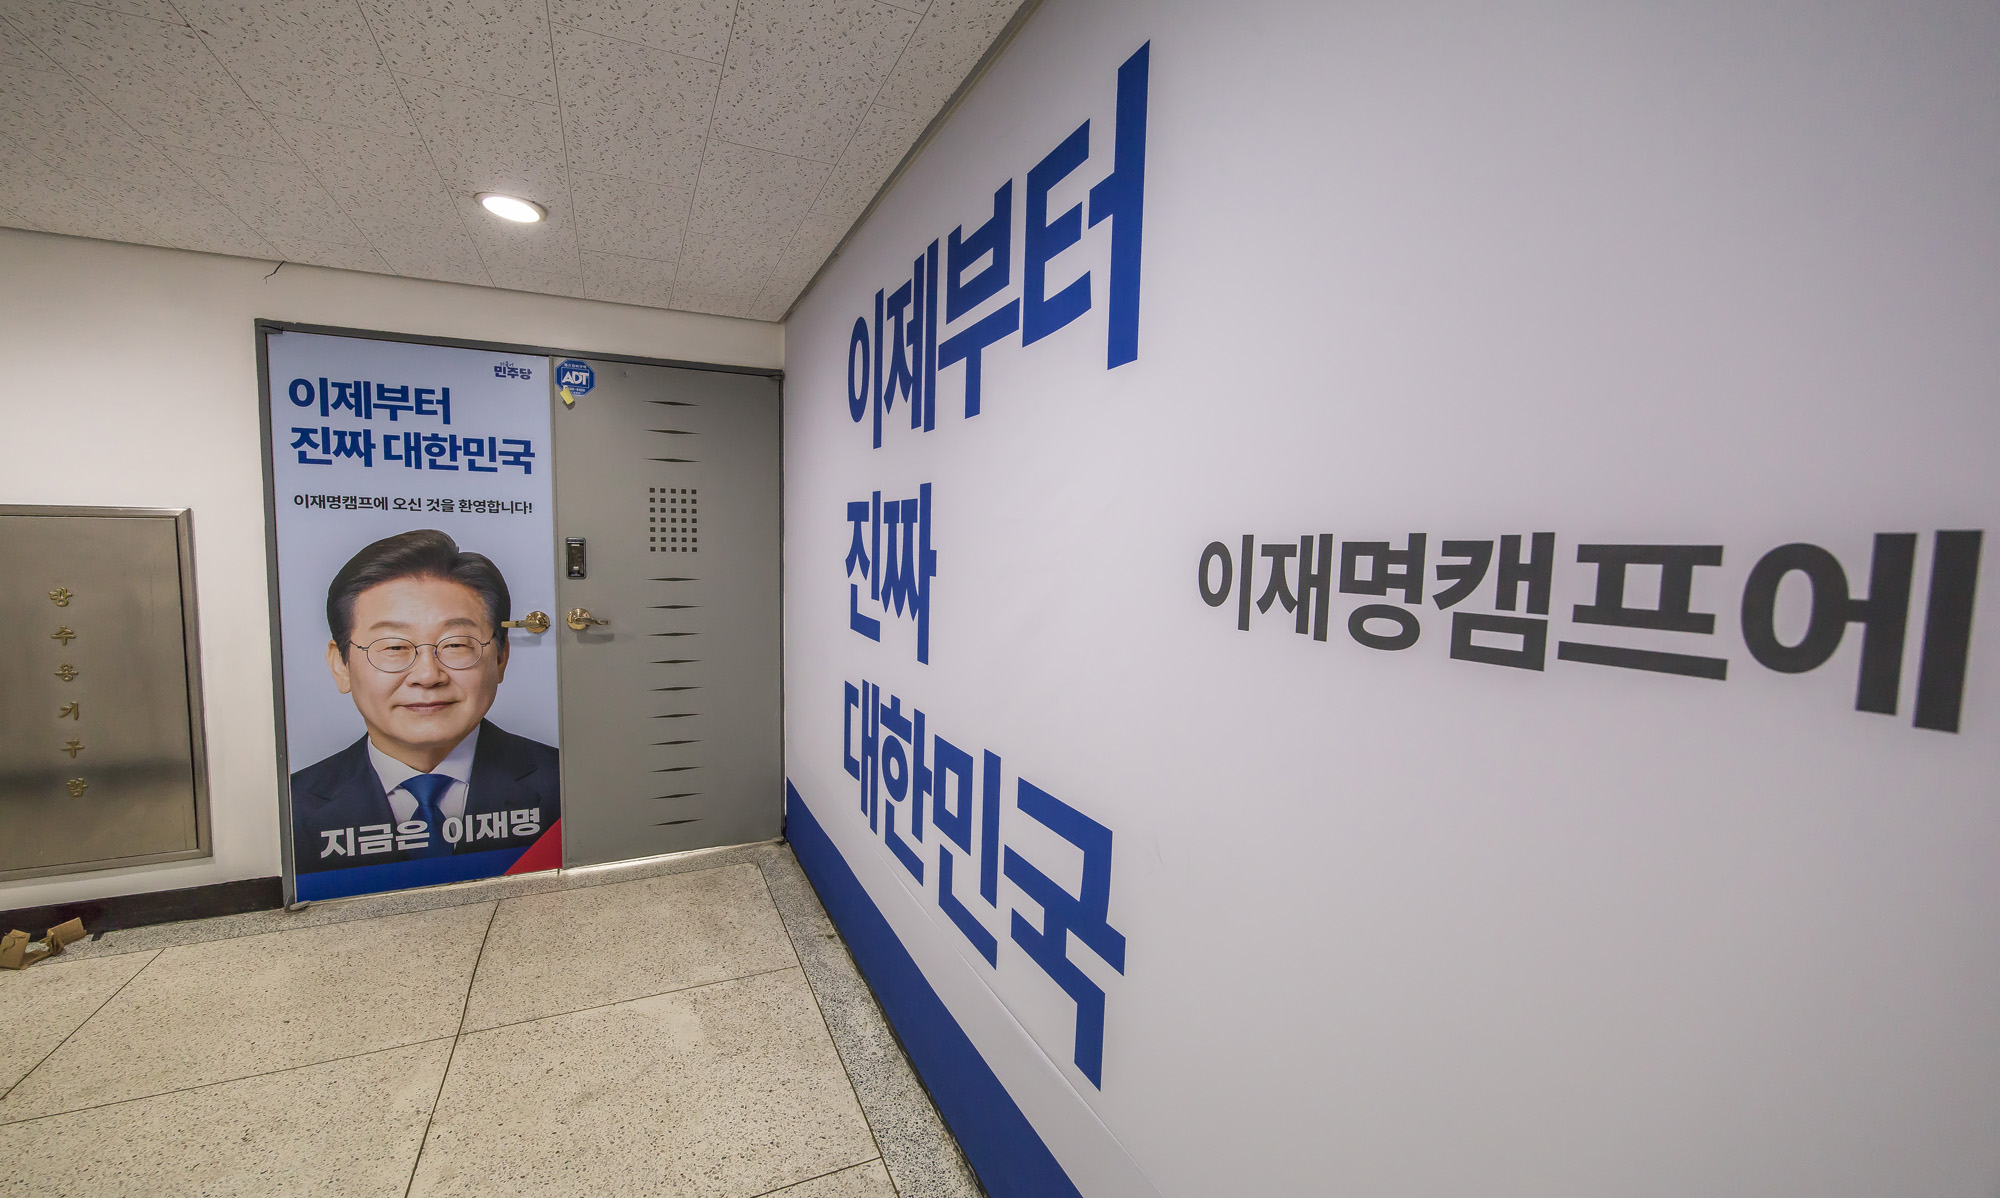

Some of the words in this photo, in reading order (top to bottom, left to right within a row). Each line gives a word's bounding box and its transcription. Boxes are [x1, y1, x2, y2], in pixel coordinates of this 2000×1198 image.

[847, 40, 1151, 449] 이제부터
[494, 365, 532, 380] 민주당
[561, 371, 589, 385] ADT
[288, 377, 451, 425] 이제부터
[290, 426, 376, 468] 진짜
[383, 431, 536, 475] 대한민국
[294, 493, 389, 511] 이재명캠프에
[392, 496, 422, 512] 오신
[426, 497, 455, 514] 것을
[458, 498, 533, 515] 환영합니다!
[845, 482, 937, 664] 진짜
[1197, 529, 1984, 733] 이재명캠프에
[48, 586, 89, 799] 방수용기구함
[320, 819, 431, 859] 지금은
[442, 807, 541, 844] 이재명
[843, 679, 1126, 1091] 대한민국
